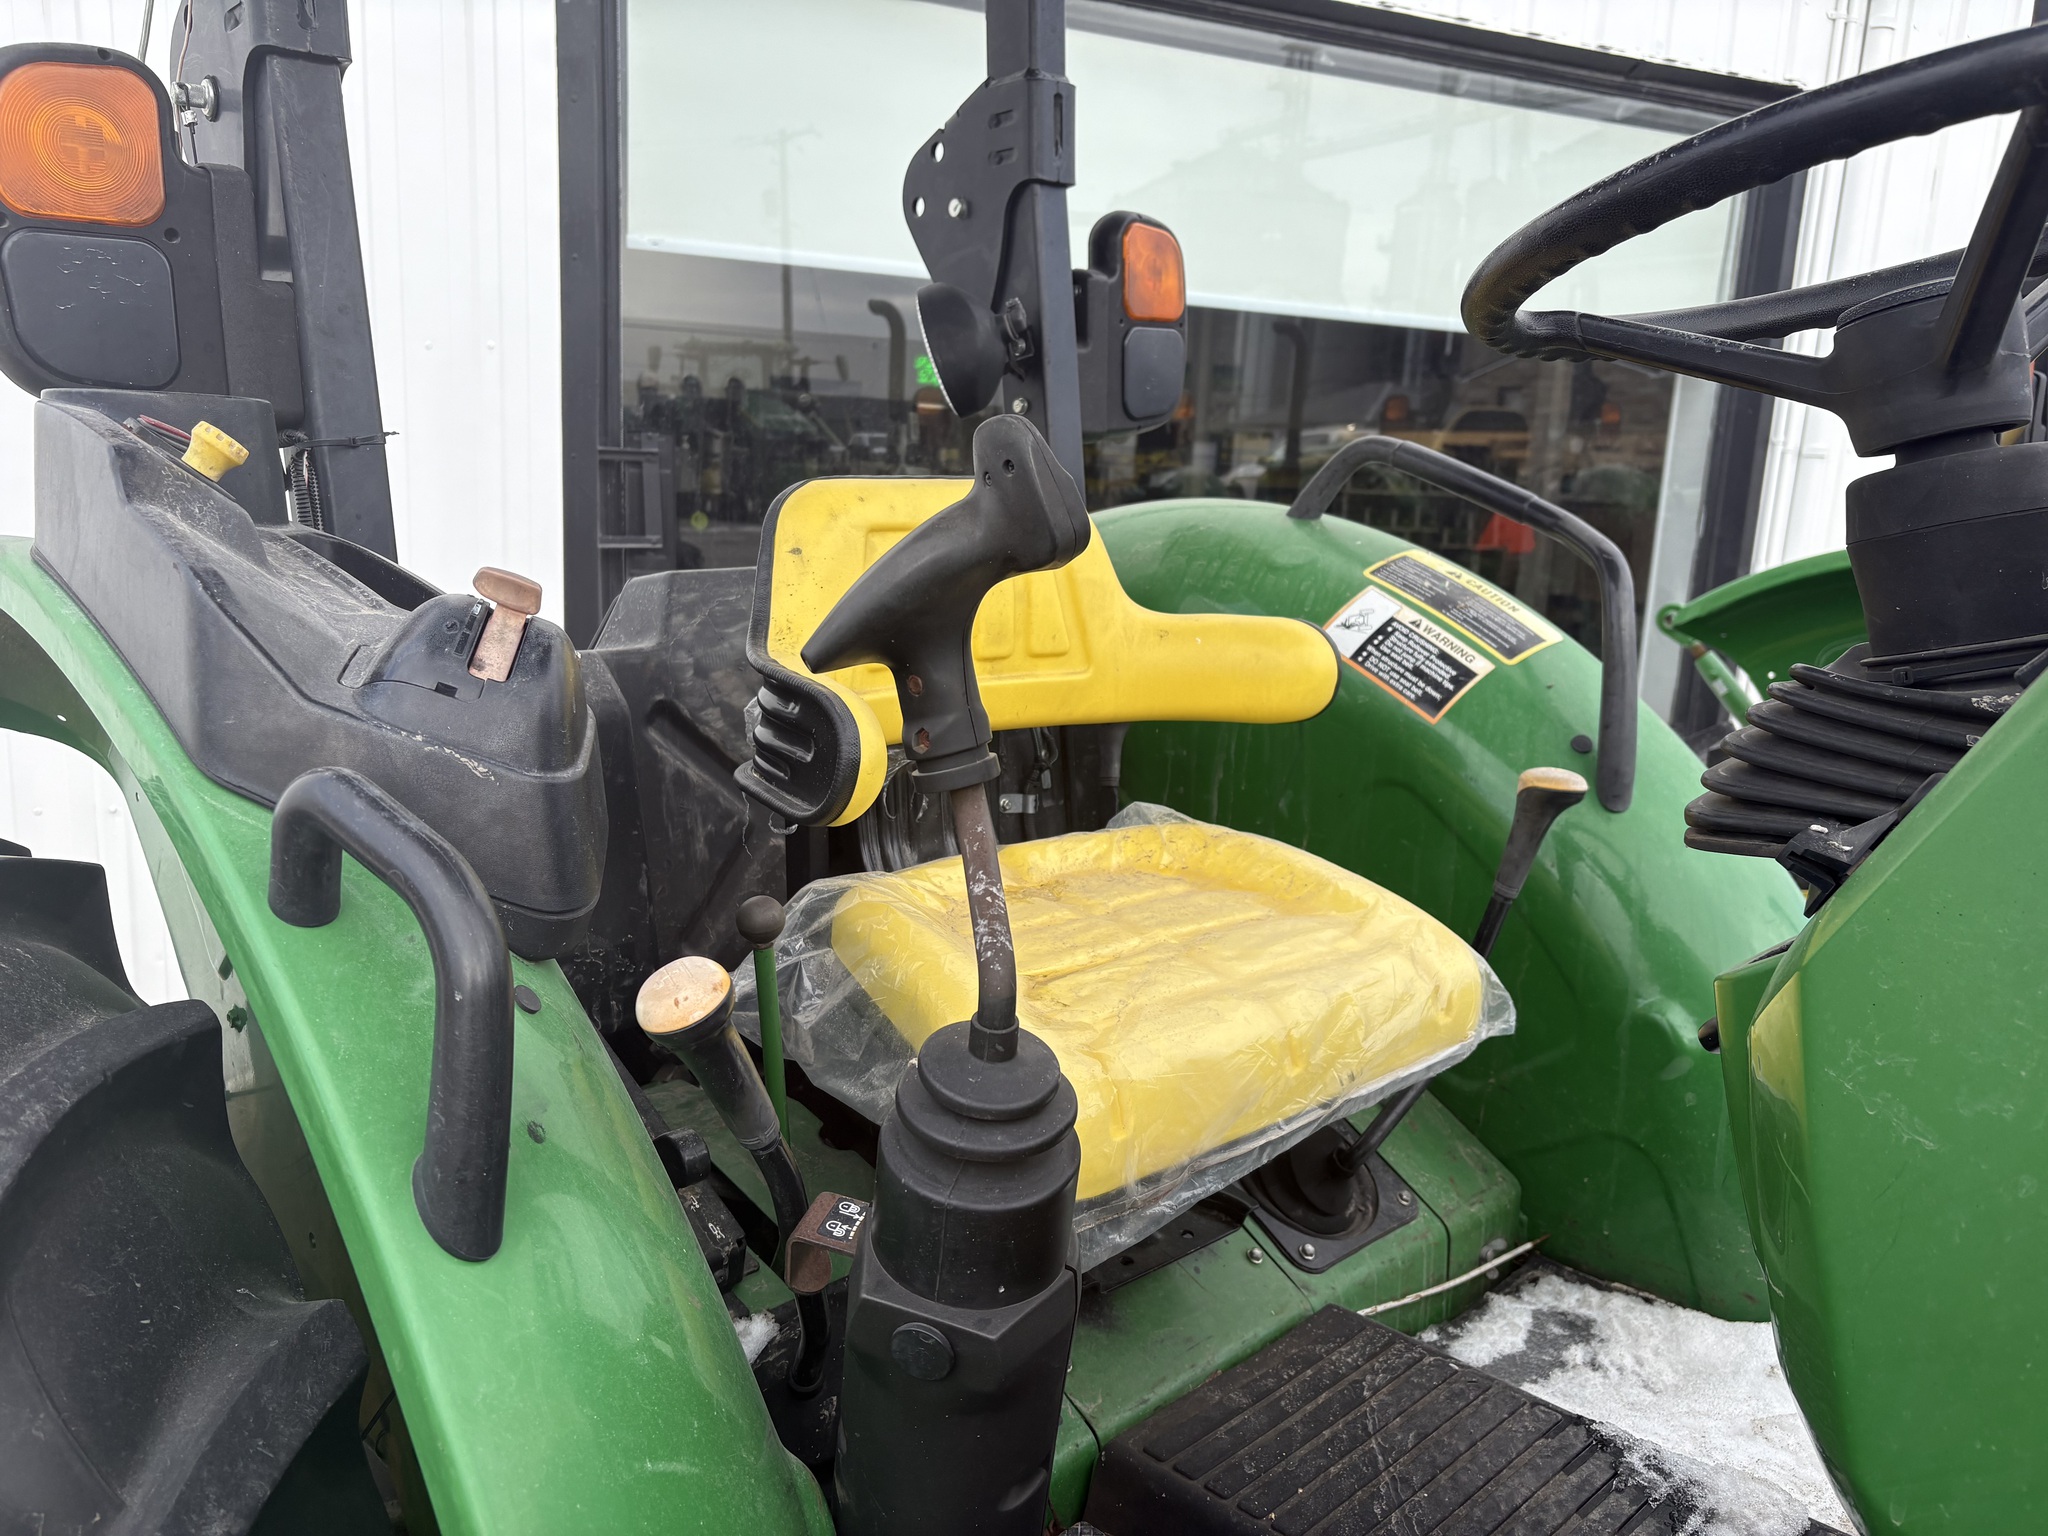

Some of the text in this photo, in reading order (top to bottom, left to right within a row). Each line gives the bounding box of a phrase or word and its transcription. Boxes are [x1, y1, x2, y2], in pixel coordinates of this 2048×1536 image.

[1466, 579, 1520, 613] CAUTION
[1388, 634, 1413, 654] Structure
[1391, 620, 1409, 635] AVOID
[1423, 624, 1476, 663] WARNING
[1366, 644, 1382, 658] When
[1381, 654, 1404, 673] structure
[1403, 670, 1418, 683] must
[1417, 679, 1426, 688] be
[1379, 643, 1391, 654] Use
[1390, 651, 1402, 662] seat
[1384, 639, 1393, 648] Do
[1392, 644, 1402, 654] not
[1401, 651, 1416, 664] jump
[1419, 663, 1443, 682] machine
[1393, 629, 1457, 676] Keep Rollover Protective
[1364, 660, 1379, 673] Drive
[1378, 670, 1390, 681] with
[1388, 678, 1403, 691] extra
[1368, 655, 1378, 664] DO
[1377, 661, 1390, 672] NOT
[1389, 670, 1399, 680] use
[1398, 676, 1411, 688] seat
